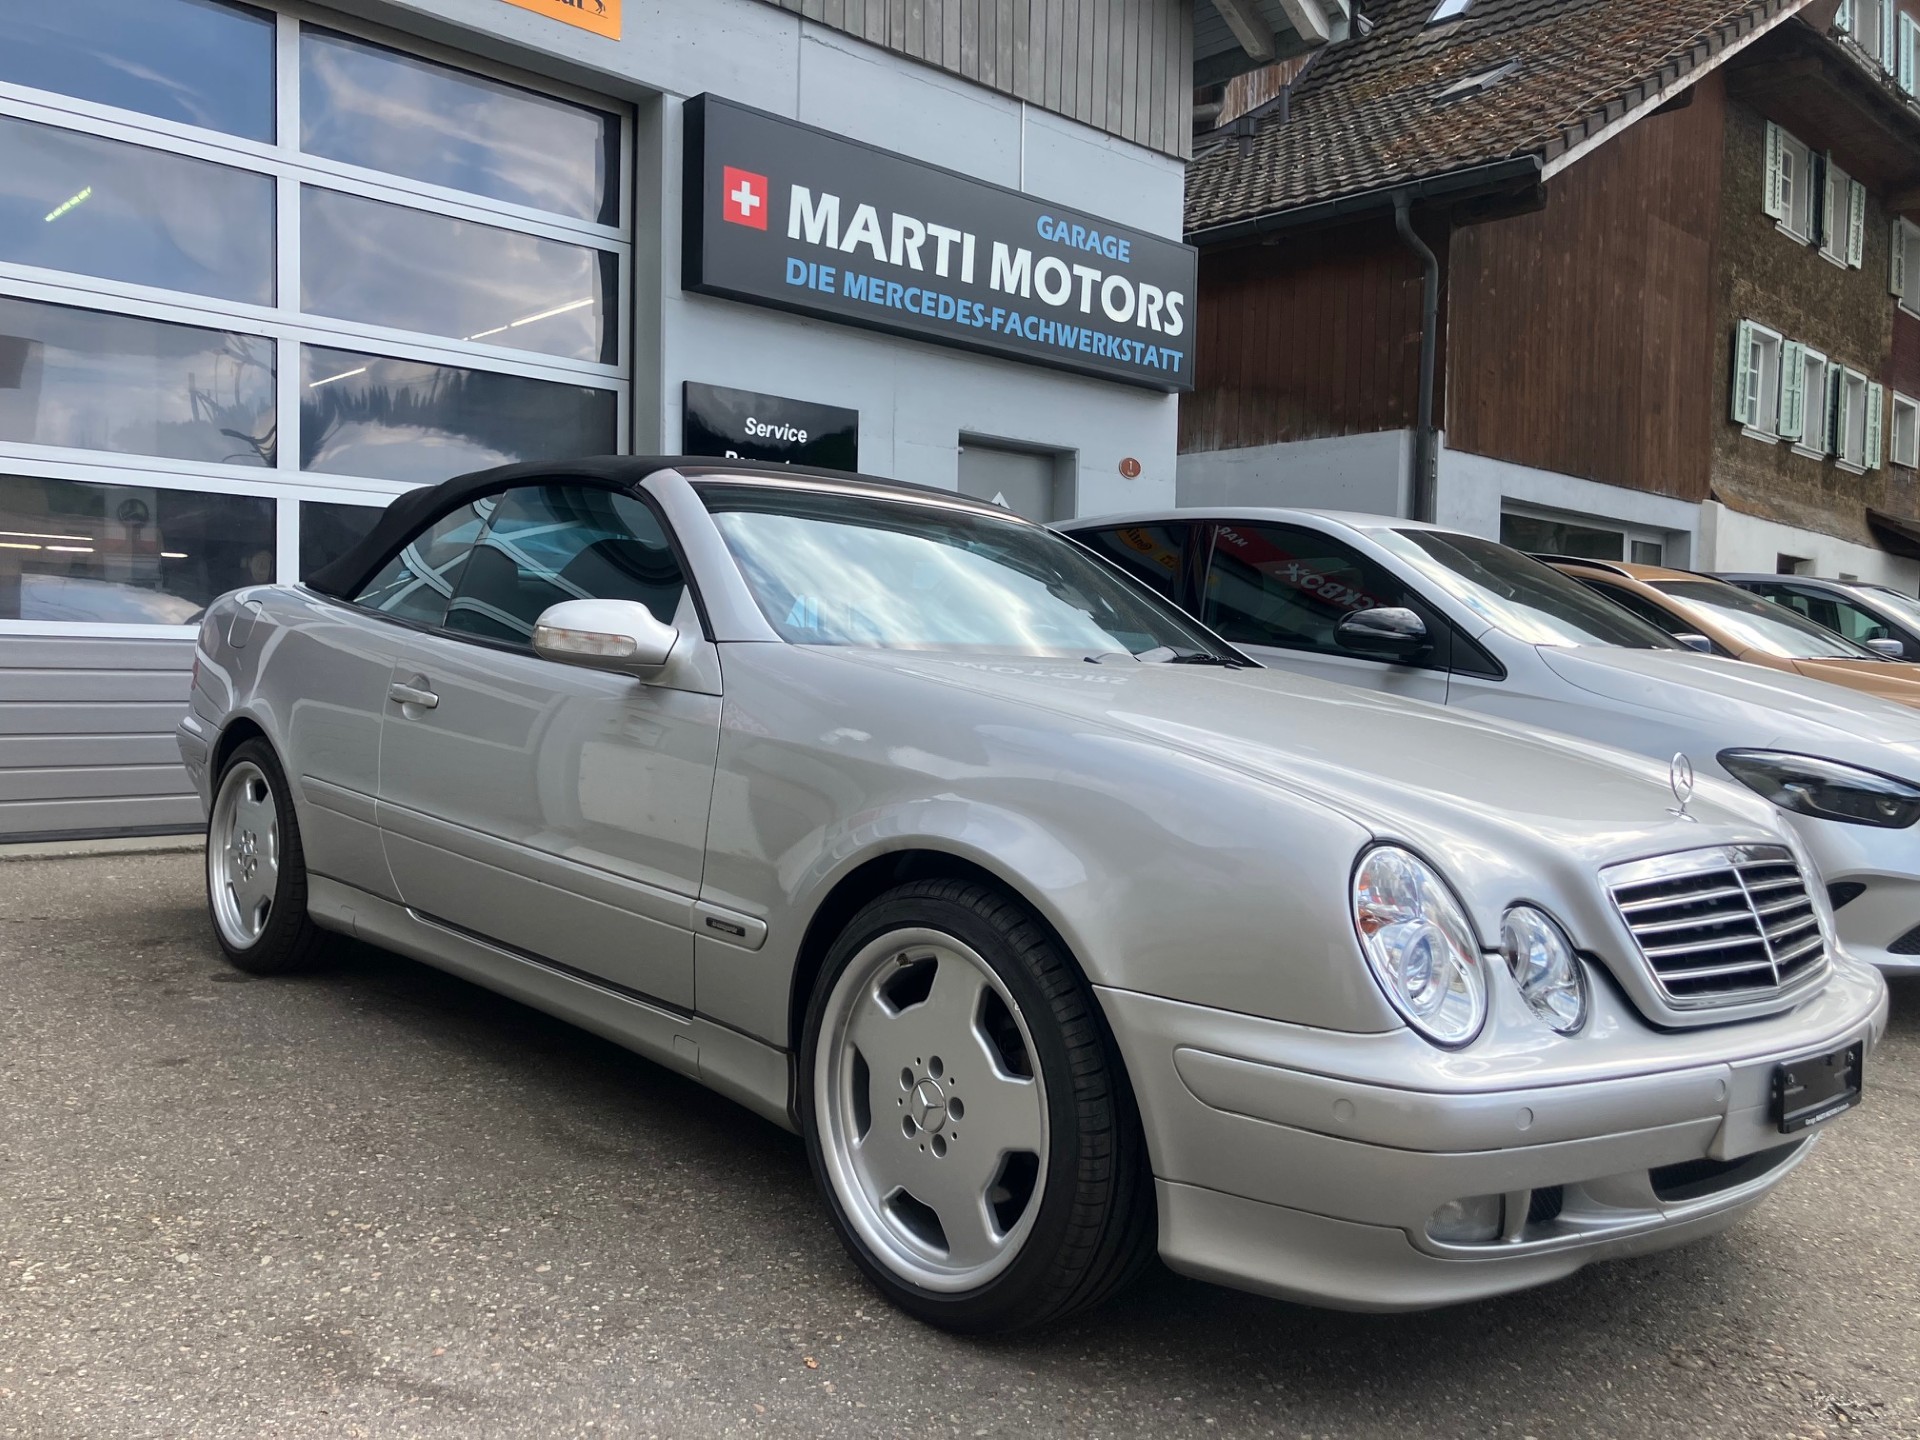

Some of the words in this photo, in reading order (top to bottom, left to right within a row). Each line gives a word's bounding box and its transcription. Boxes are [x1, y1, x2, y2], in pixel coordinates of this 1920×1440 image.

[787, 183, 976, 284] MARTI
[989, 240, 1184, 337] MOTORS
[1036, 213, 1133, 264] GARAGE
[785, 256, 837, 294] DIE
[842, 269, 1184, 373] MERCEDES-FACHWERKSTATT
[744, 416, 808, 443] Service
